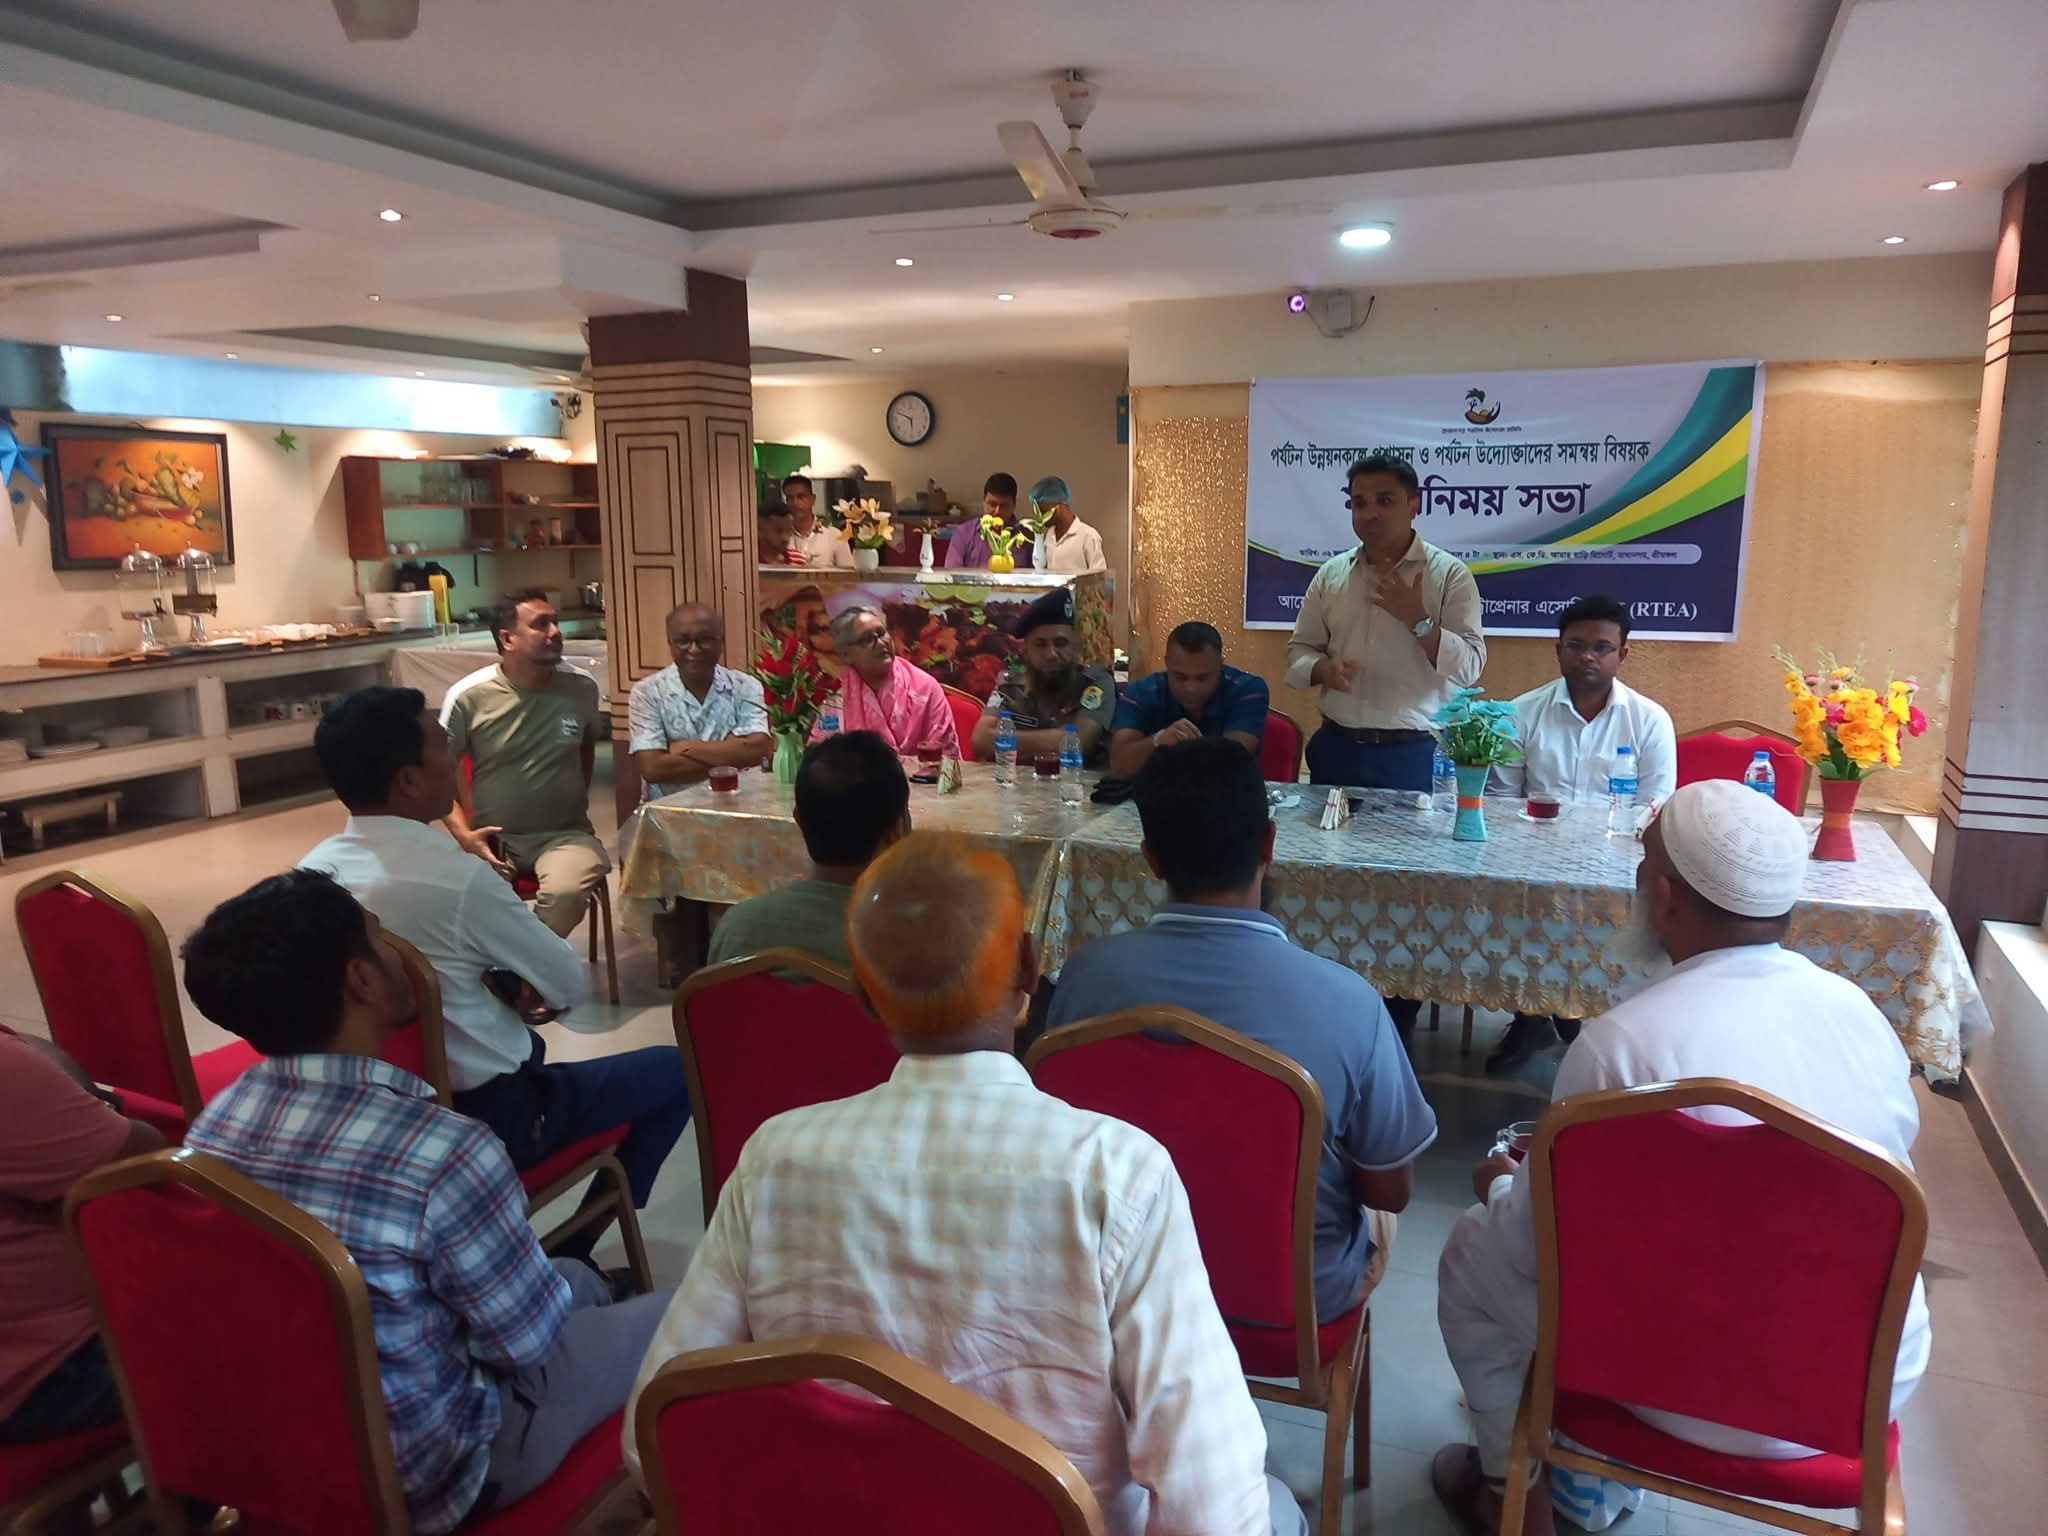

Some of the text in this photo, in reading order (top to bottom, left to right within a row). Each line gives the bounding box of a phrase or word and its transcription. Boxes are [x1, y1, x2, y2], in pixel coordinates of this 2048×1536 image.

[1270, 440, 1304, 467] পর্যটন
[1419, 447, 1430, 464] ও
[1435, 438, 1471, 466] পর্যটন
[1476, 438, 1553, 466] উদ্যোক্তাদের
[1557, 441, 1601, 464] সমন্বয়
[1604, 434, 1651, 463] বিষয়ক
[1515, 481, 1592, 516] সভা
[1629, 601, 1698, 621] (RTEA)
